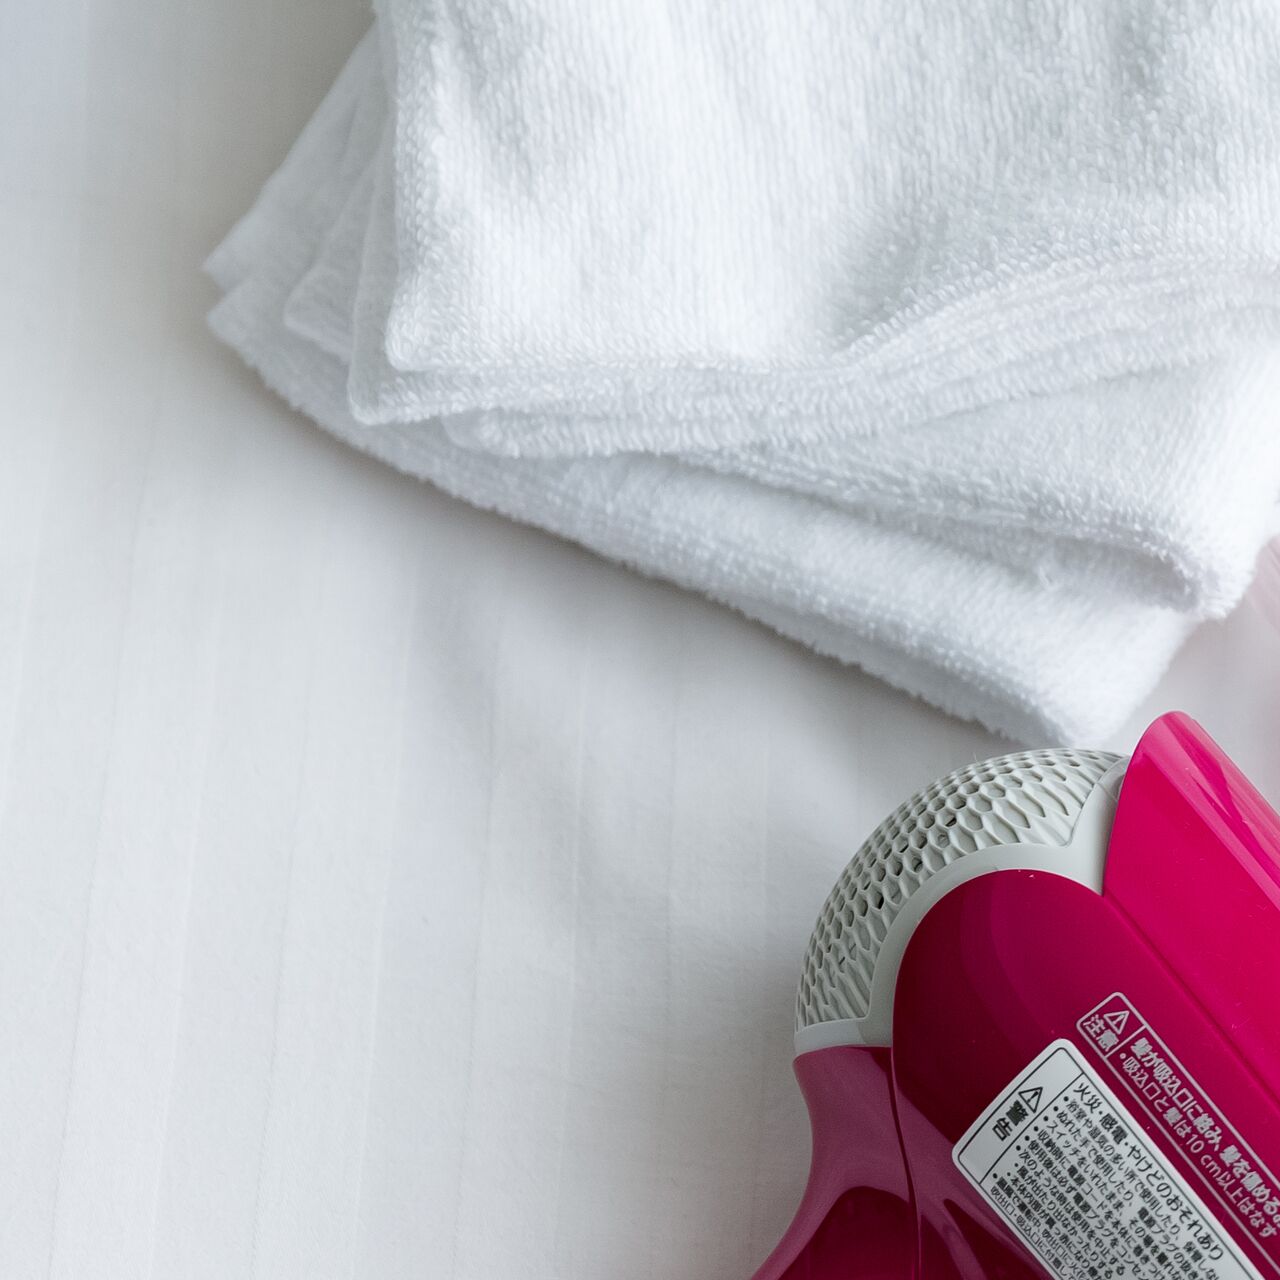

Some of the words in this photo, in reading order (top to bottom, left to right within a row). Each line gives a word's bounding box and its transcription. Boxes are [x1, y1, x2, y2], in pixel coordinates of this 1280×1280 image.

[1081, 1012, 1120, 1053] 注意
[991, 1099, 1030, 1142] 警告
[1072, 1079, 1226, 1263] 火災・感電・やけどのおそれあり
